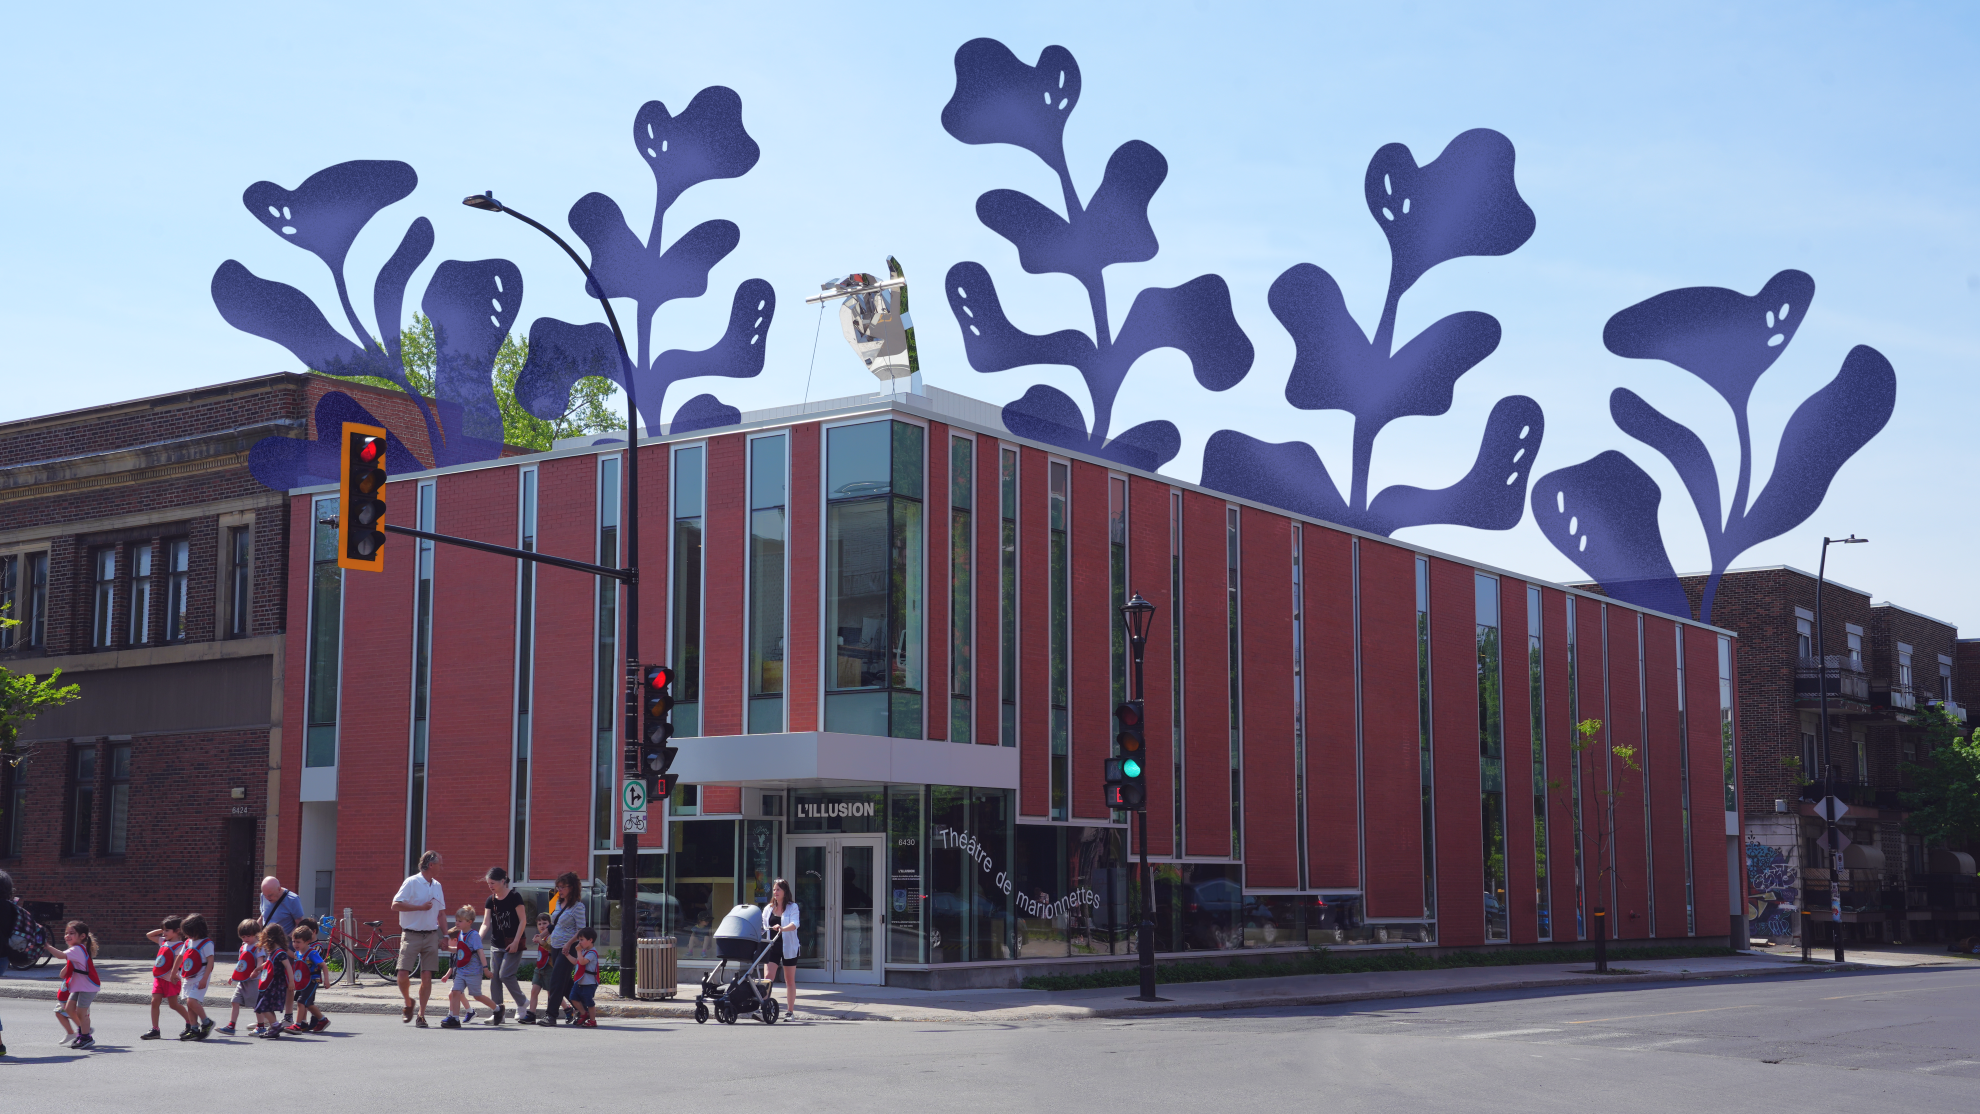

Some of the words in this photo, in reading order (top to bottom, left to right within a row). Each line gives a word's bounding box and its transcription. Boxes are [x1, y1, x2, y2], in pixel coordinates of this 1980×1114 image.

[232, 806, 248, 814] 6424
[797, 802, 875, 818] L'ILLUSION
[898, 838, 916, 846] 6430
[940, 827, 993, 873] Théâtre
[995, 871, 1012, 895] de
[1016, 886, 1101, 919] marionnettes
